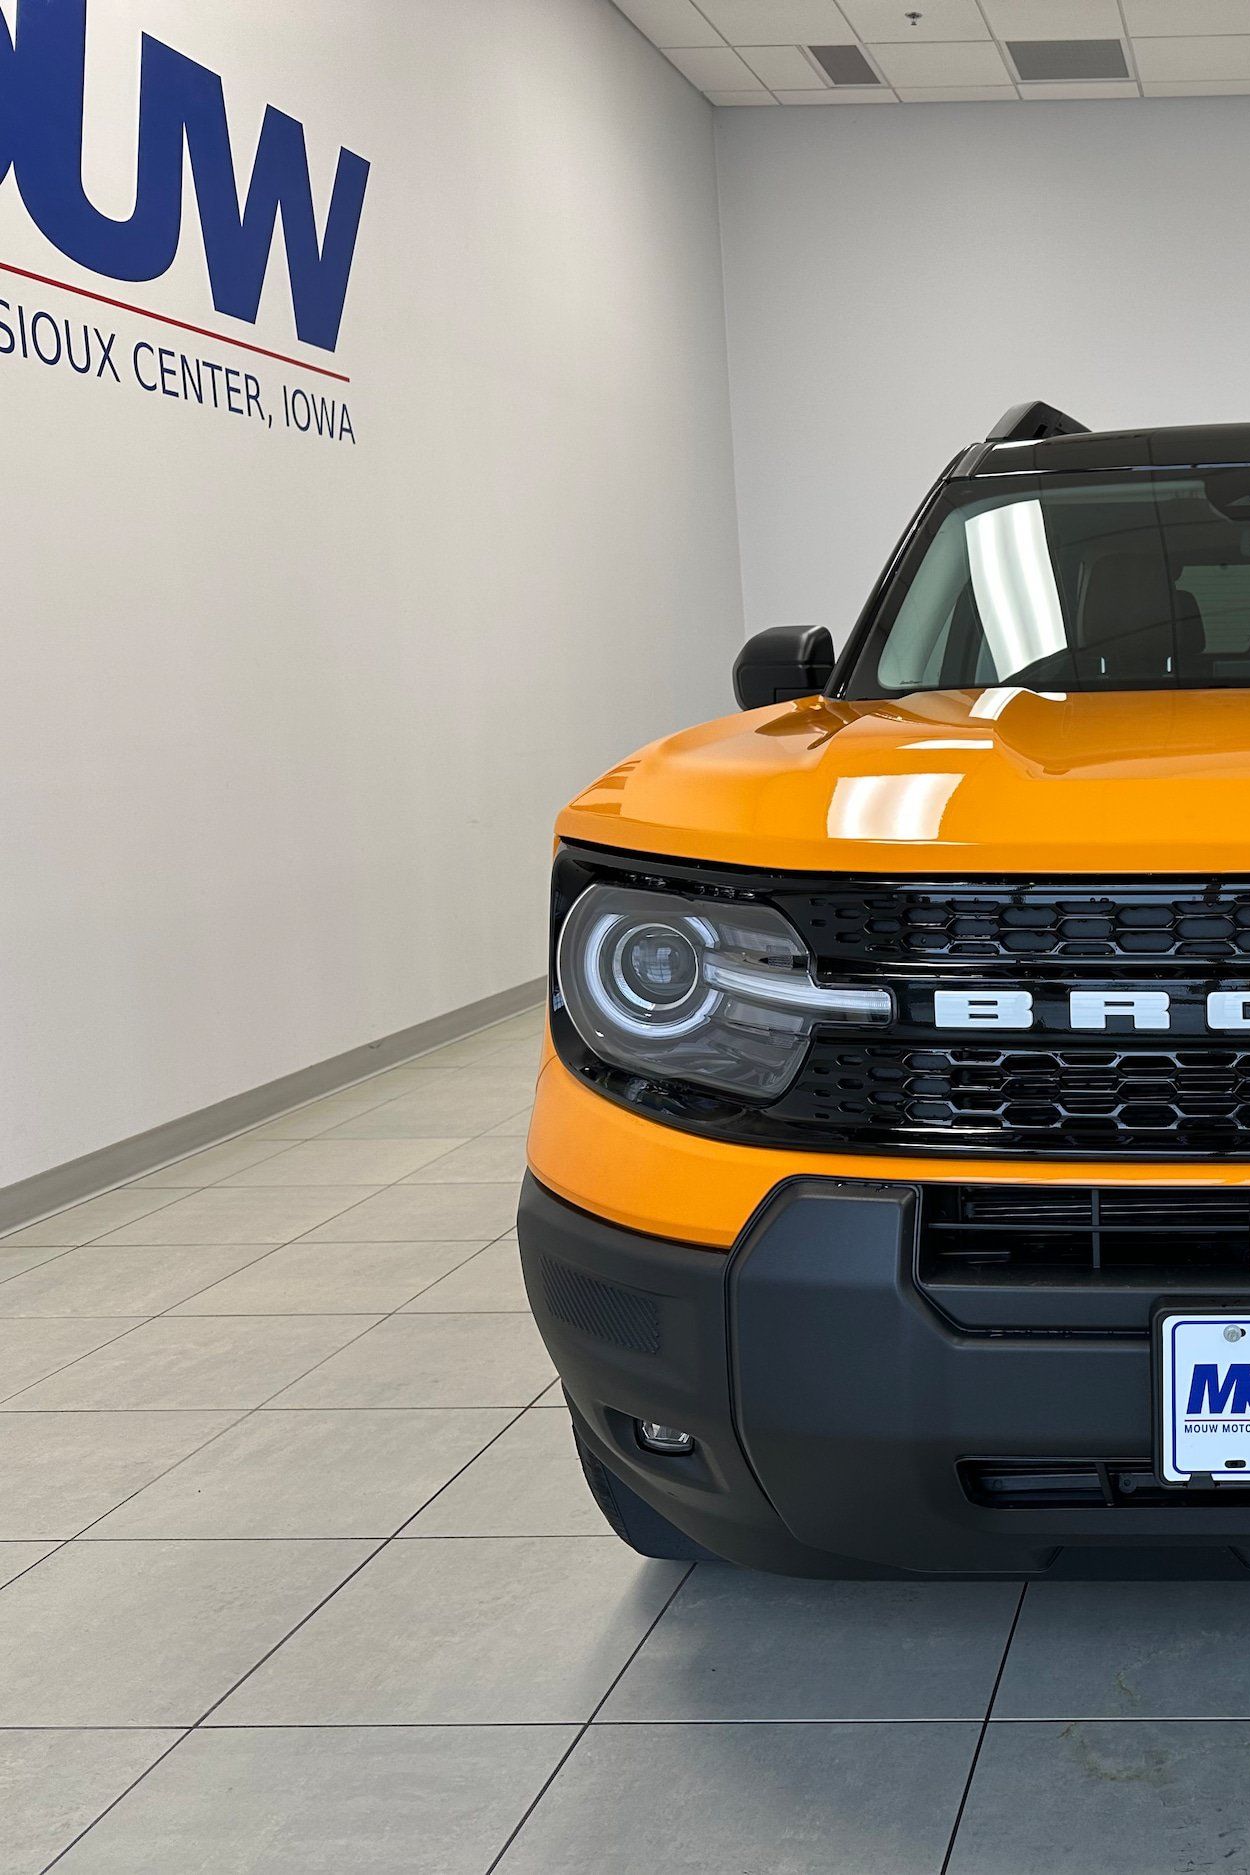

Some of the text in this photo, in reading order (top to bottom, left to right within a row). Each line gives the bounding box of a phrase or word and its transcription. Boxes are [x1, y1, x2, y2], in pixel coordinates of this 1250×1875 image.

[0, 0, 371, 353] UW
[132, 341, 274, 429] CENTER,
[282, 384, 356, 445] IOWA
[1184, 1424, 1218, 1434] MOUW
